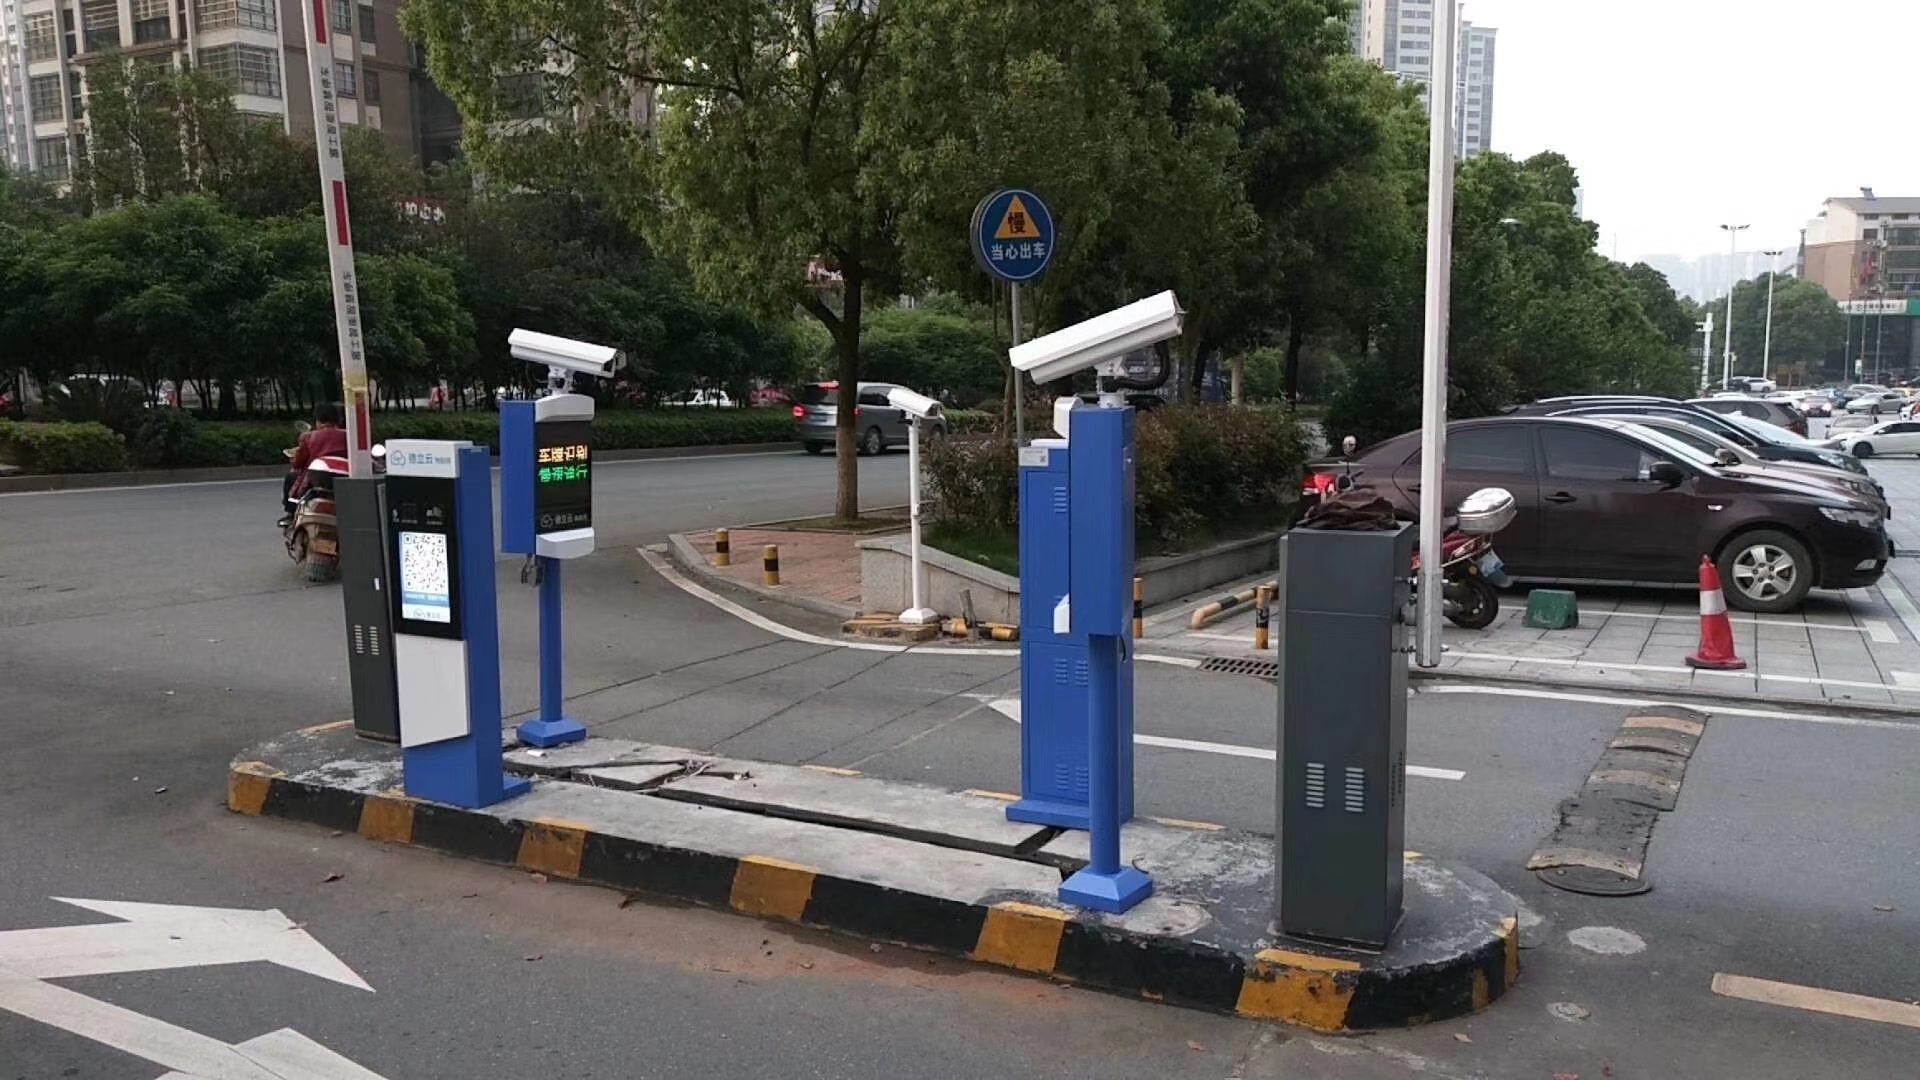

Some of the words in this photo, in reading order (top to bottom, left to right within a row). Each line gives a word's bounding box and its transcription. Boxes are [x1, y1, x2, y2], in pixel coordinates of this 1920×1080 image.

[1007, 211, 1026, 234] 慢
[991, 241, 1046, 261] 当心出车
[537, 444, 588, 463] 车牌识别
